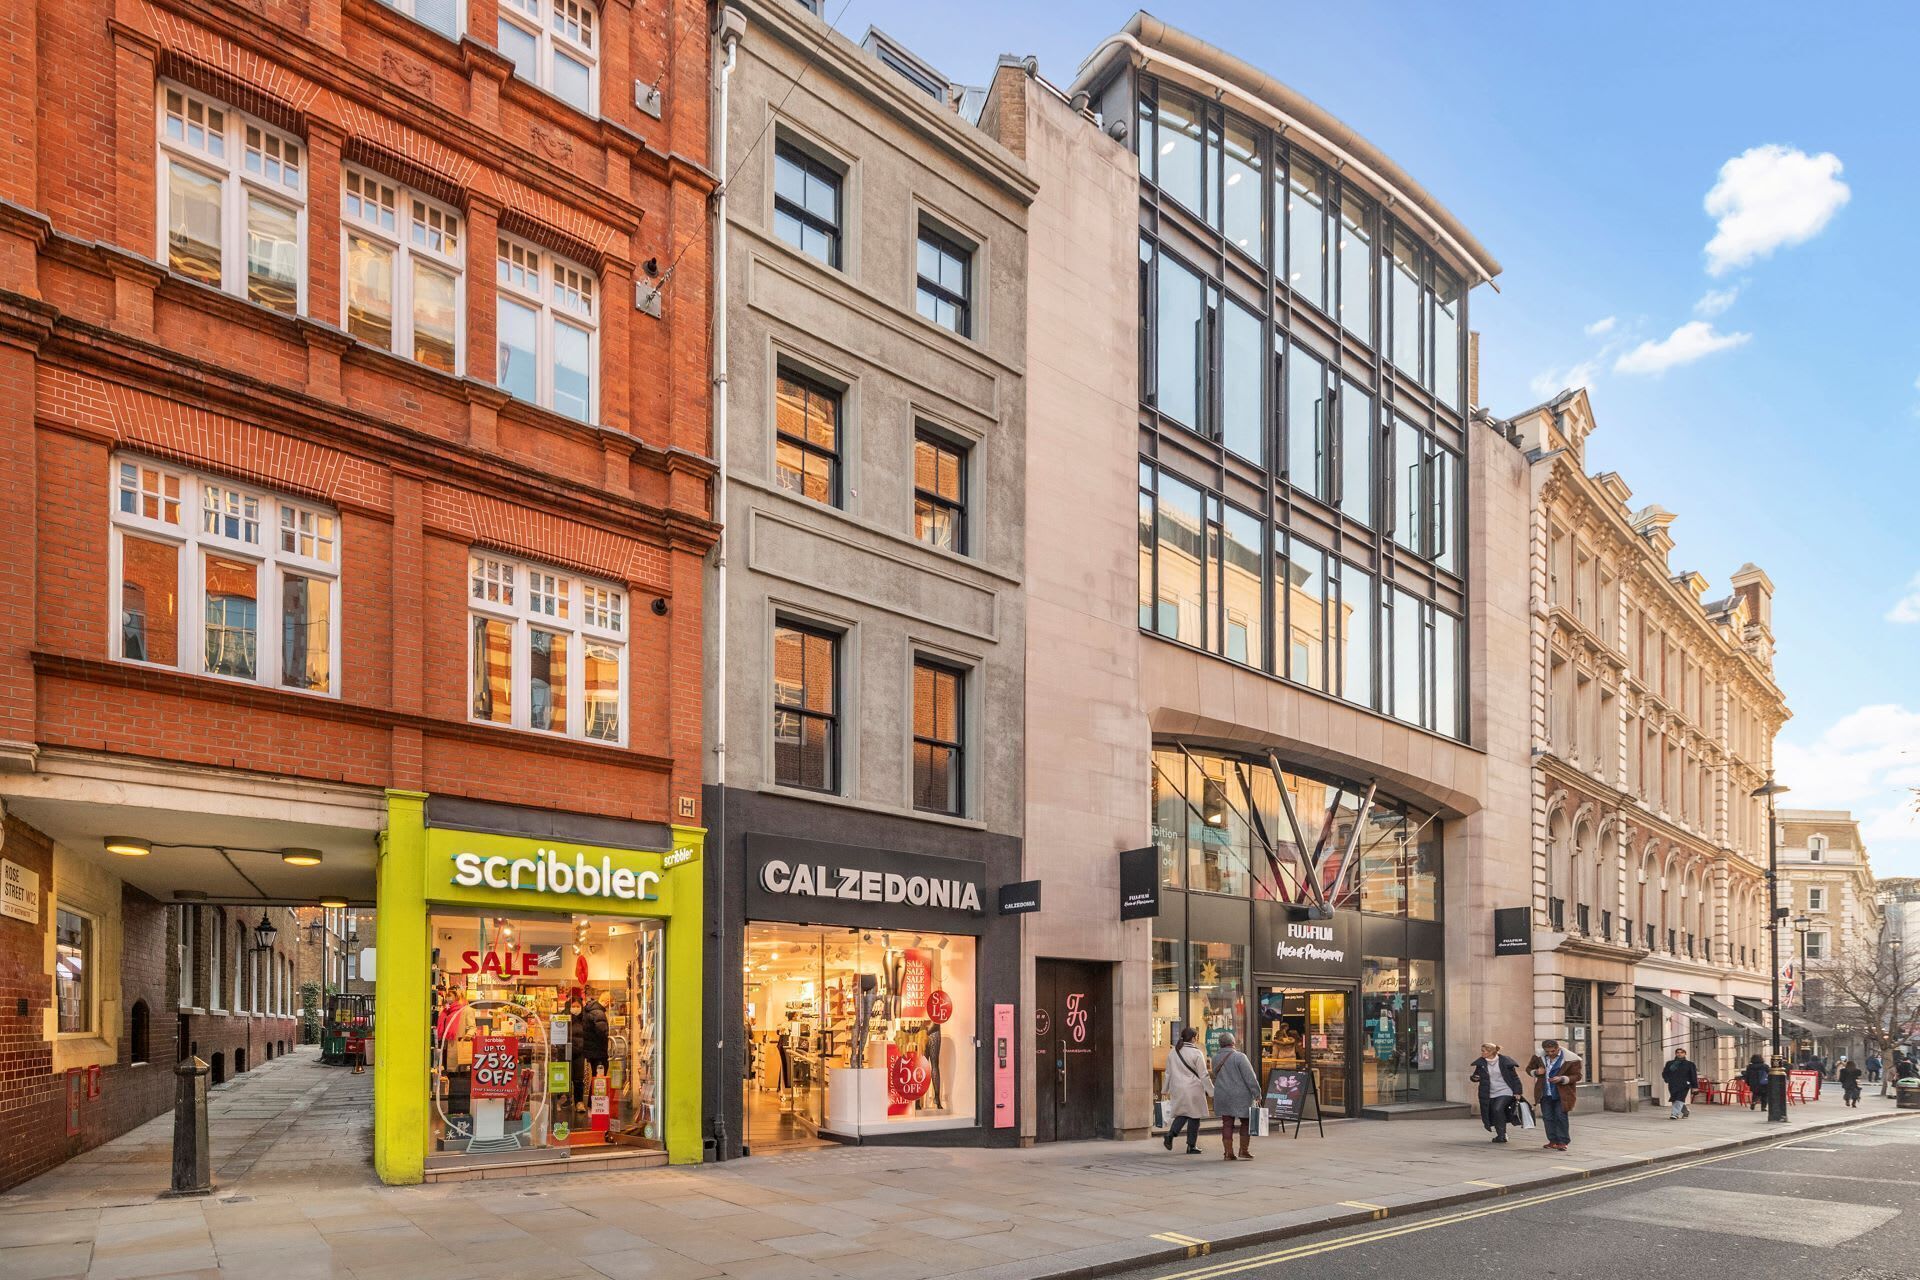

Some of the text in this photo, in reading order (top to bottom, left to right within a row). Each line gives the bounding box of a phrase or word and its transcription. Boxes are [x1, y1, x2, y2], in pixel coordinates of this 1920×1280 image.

[664, 847, 694, 868] scribbler
[5, 865, 19, 882] ROSE
[455, 848, 660, 900] scribbler
[5, 882, 37, 906] STREET WC2
[762, 859, 981, 911] CALZEDONIA
[1004, 901, 1036, 910] CALZEDONIA
[1288, 923, 1333, 941] FUJIFILM
[462, 951, 538, 976] SALE
[473, 1053, 515, 1069] 75%
[477, 1069, 514, 1085] OFF
[903, 1084, 923, 1093] OFF
